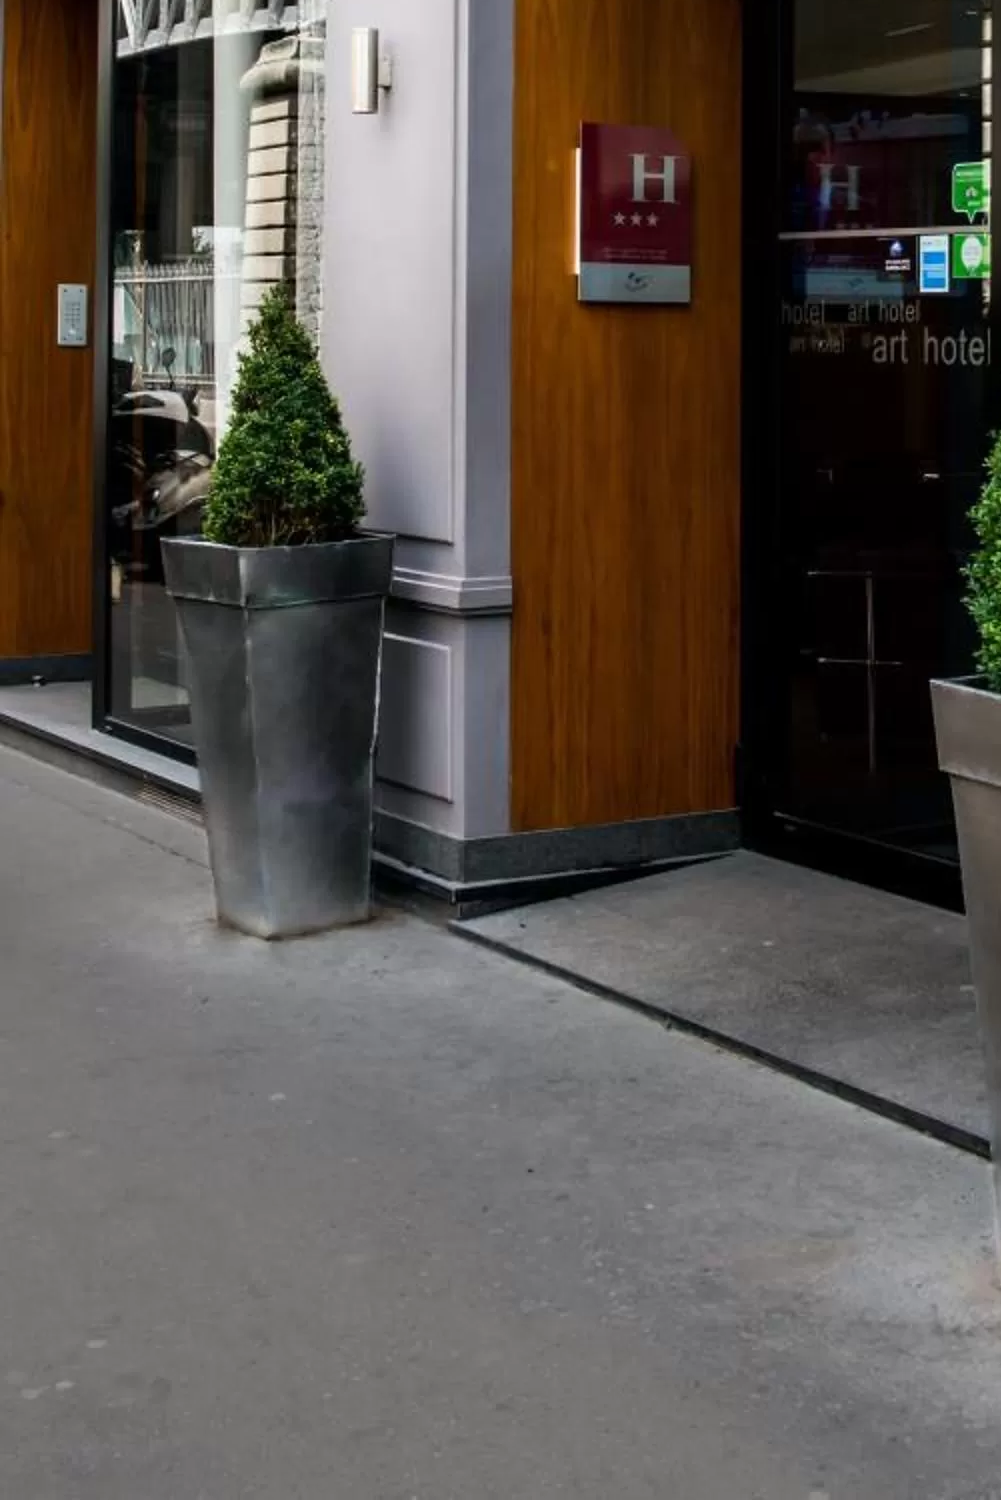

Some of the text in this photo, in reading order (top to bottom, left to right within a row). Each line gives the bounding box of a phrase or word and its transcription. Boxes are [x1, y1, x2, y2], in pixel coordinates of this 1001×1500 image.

[629, 153, 682, 204] H
[878, 299, 921, 324] hotel
[872, 325, 991, 366] art hotel
